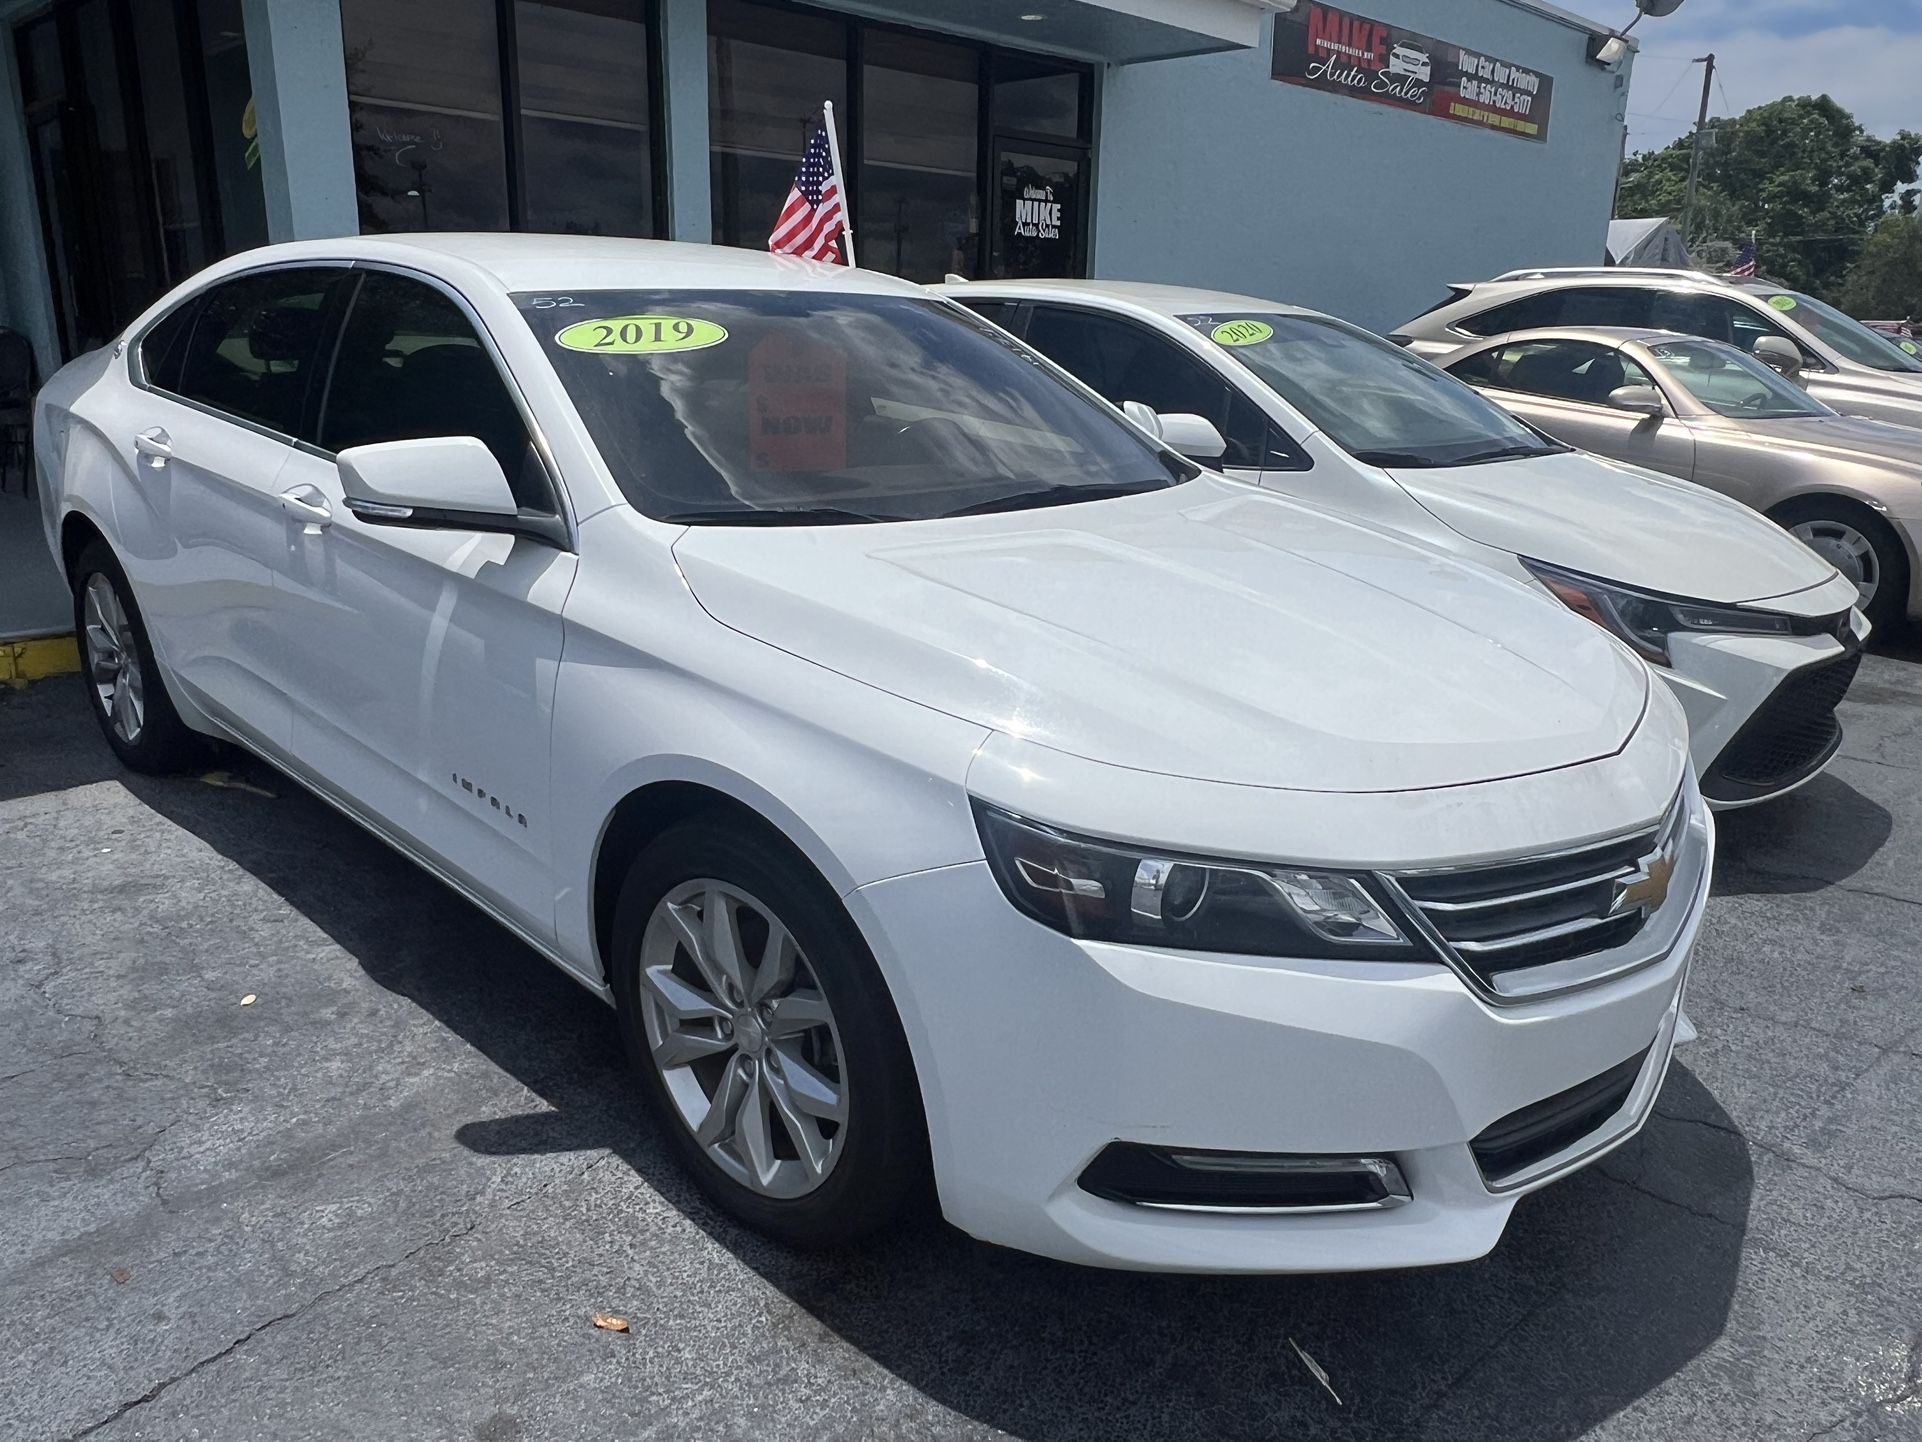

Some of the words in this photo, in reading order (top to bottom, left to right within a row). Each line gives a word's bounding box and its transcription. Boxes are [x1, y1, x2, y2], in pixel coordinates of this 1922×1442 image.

[1308, 6, 1388, 70] MIKE
[1305, 54, 1368, 88] Auto
[1371, 68, 1428, 104] Sales
[1458, 49, 1478, 74] Your
[1494, 62, 1510, 84] Our
[1509, 67, 1540, 95] Priority
[1015, 199, 1061, 226] MIKE
[1014, 217, 1038, 237] Auto
[1038, 220, 1059, 240] Sales
[532, 296, 586, 310] 52
[592, 320, 695, 348] 2019
[1220, 321, 1263, 343] 2020
[452, 773, 528, 829] IMPALA
